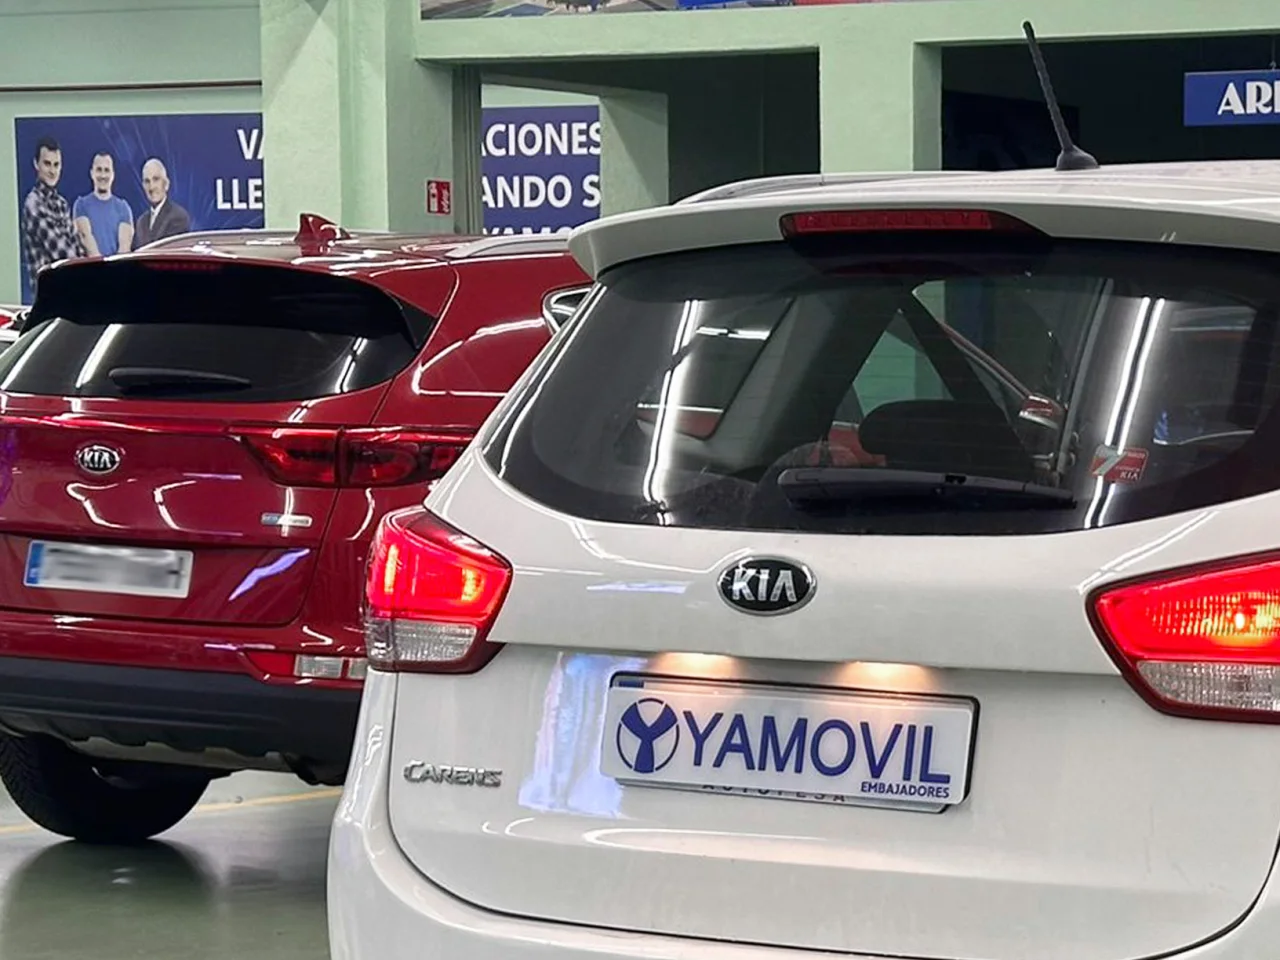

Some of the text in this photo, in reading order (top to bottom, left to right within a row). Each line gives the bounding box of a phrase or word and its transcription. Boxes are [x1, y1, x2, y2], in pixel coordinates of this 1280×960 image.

[83, 450, 112, 468] KIA
[732, 568, 798, 602] KIA
[683, 710, 951, 784] YAMOVIL
[403, 759, 503, 788] CARENS
[860, 780, 951, 799] EMBAJADORES
